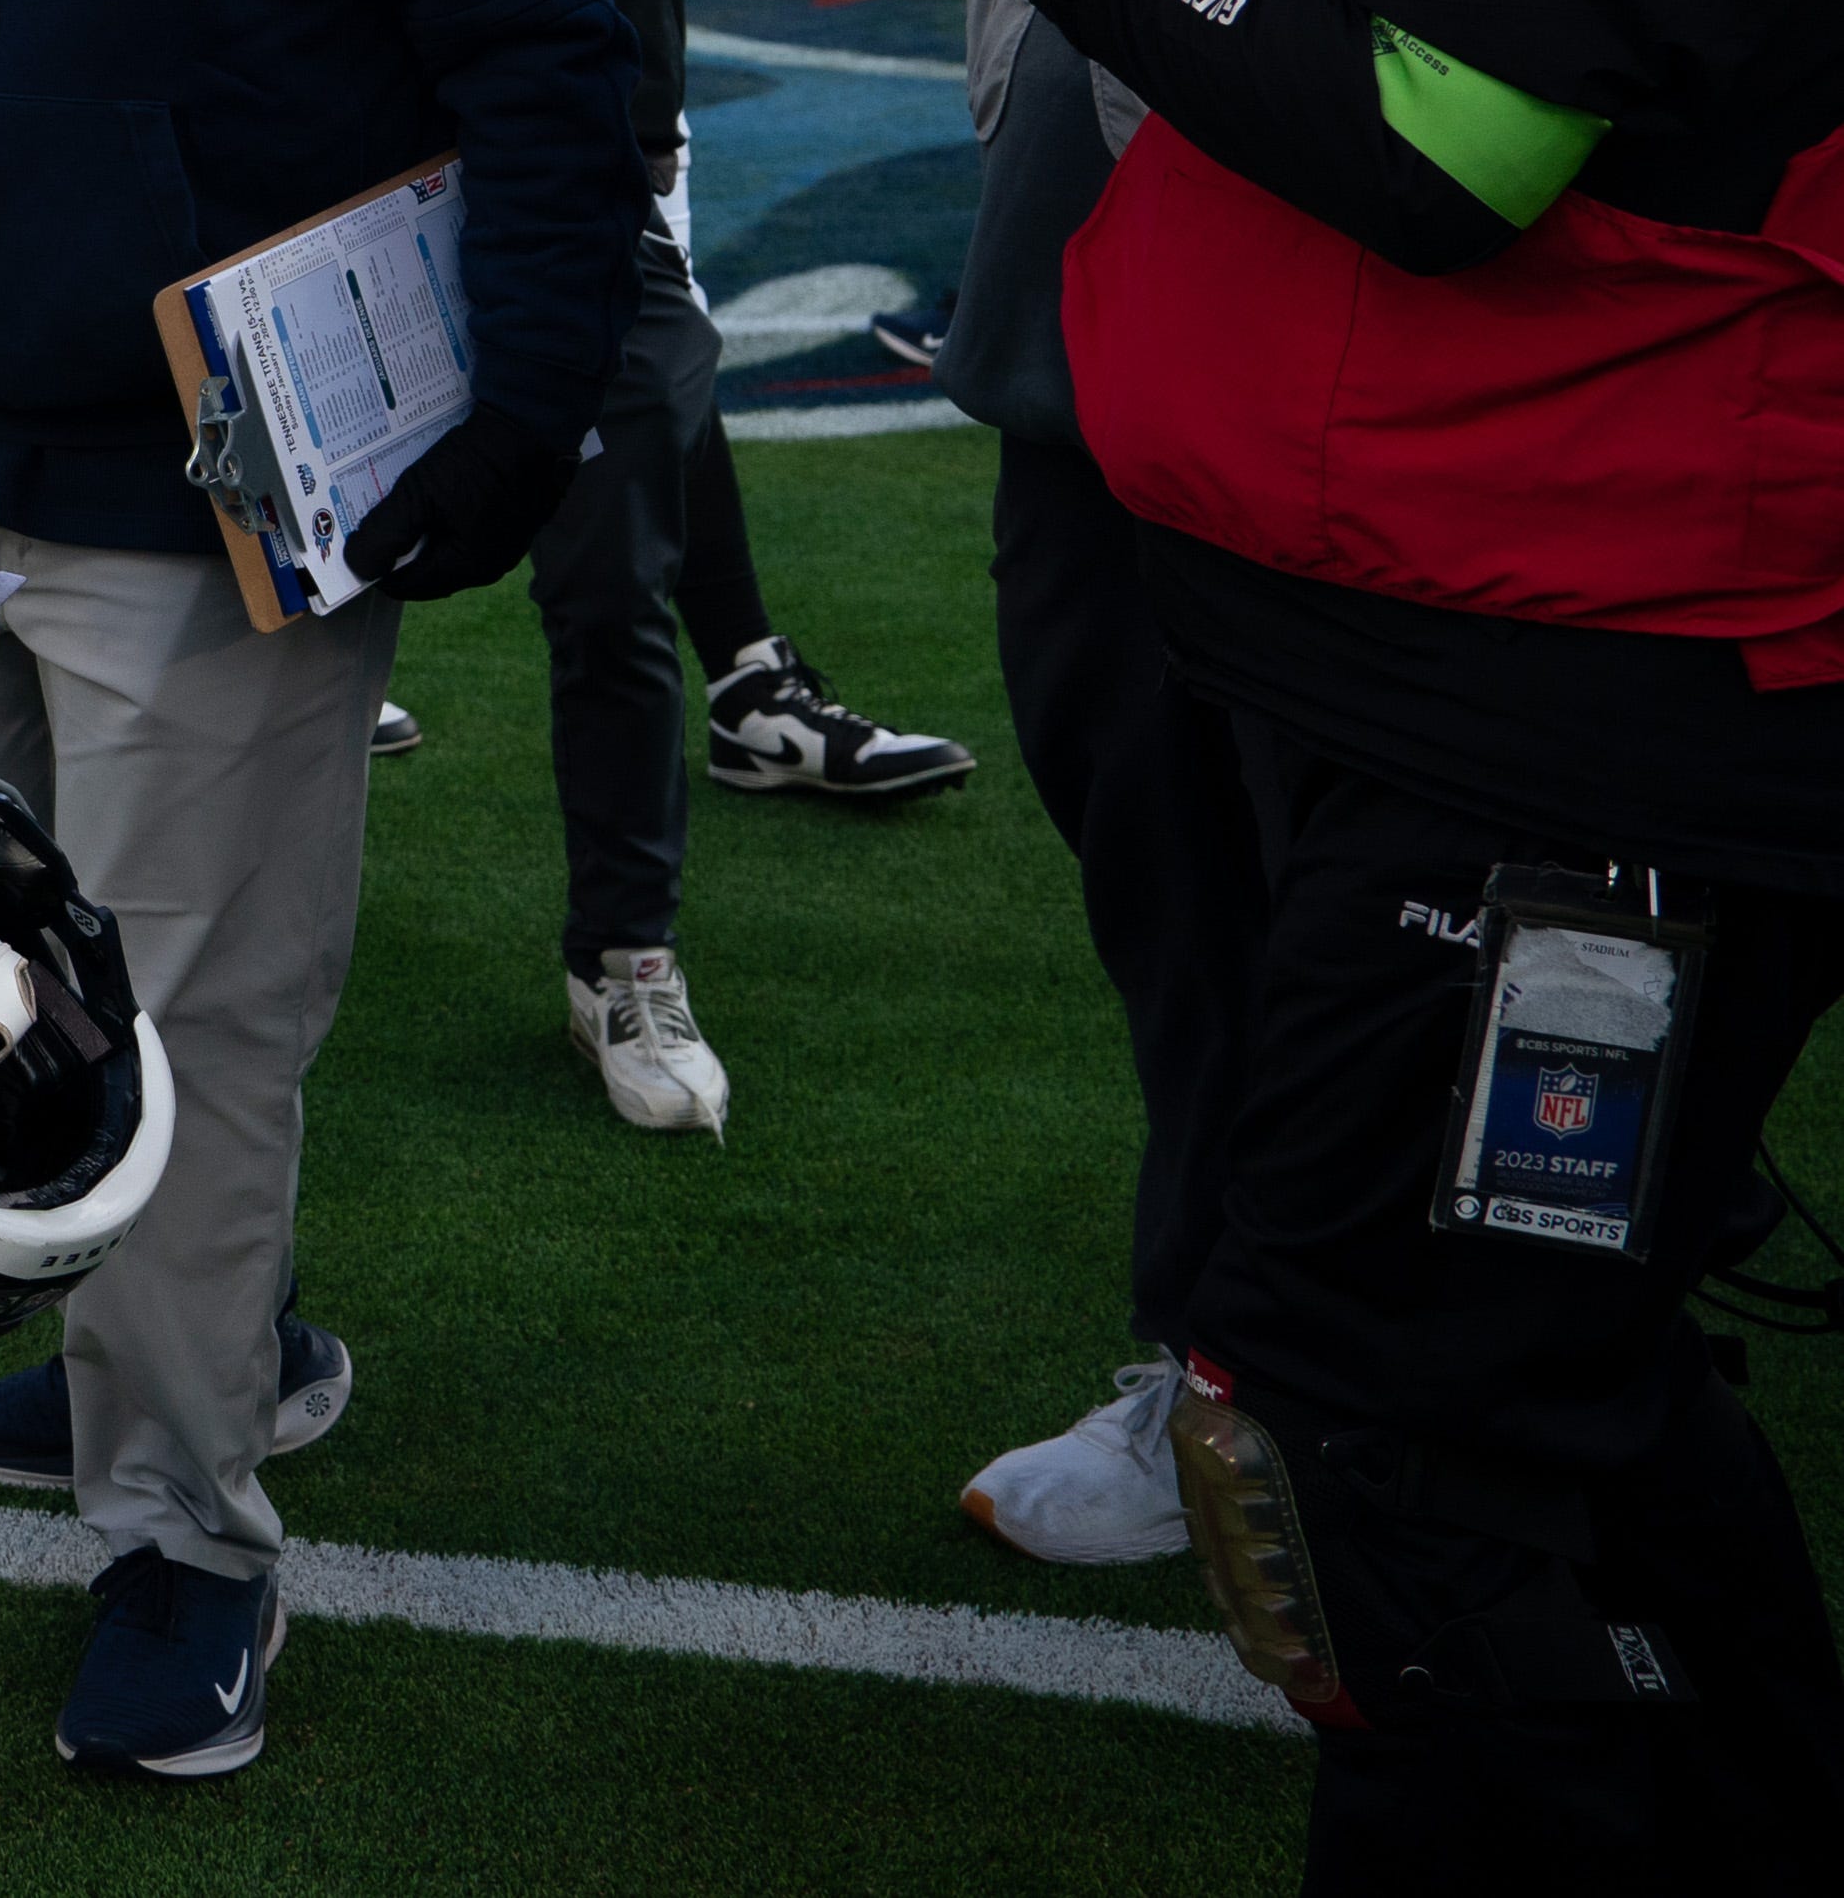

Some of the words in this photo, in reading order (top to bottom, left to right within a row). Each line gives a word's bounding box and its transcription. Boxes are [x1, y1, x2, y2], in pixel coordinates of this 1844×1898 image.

[1399, 29, 1449, 77] Access
[252, 333, 271, 378] TITANS
[368, 339, 387, 381] JAGUARS
[267, 378, 297, 455] TENNESSEE
[1580, 941, 1630, 959] STADIUM
[1526, 1039, 1550, 1054] CBS
[1552, 1042, 1598, 1059] SPORTS
[1605, 1047, 1630, 1062] NFL
[1540, 1094, 1586, 1130] NFL
[1494, 1149, 1546, 1172] 2023
[1549, 1155, 1618, 1179] STAFF
[1492, 1202, 1533, 1227] CBS
[1538, 1213, 1622, 1242] SPORTS
